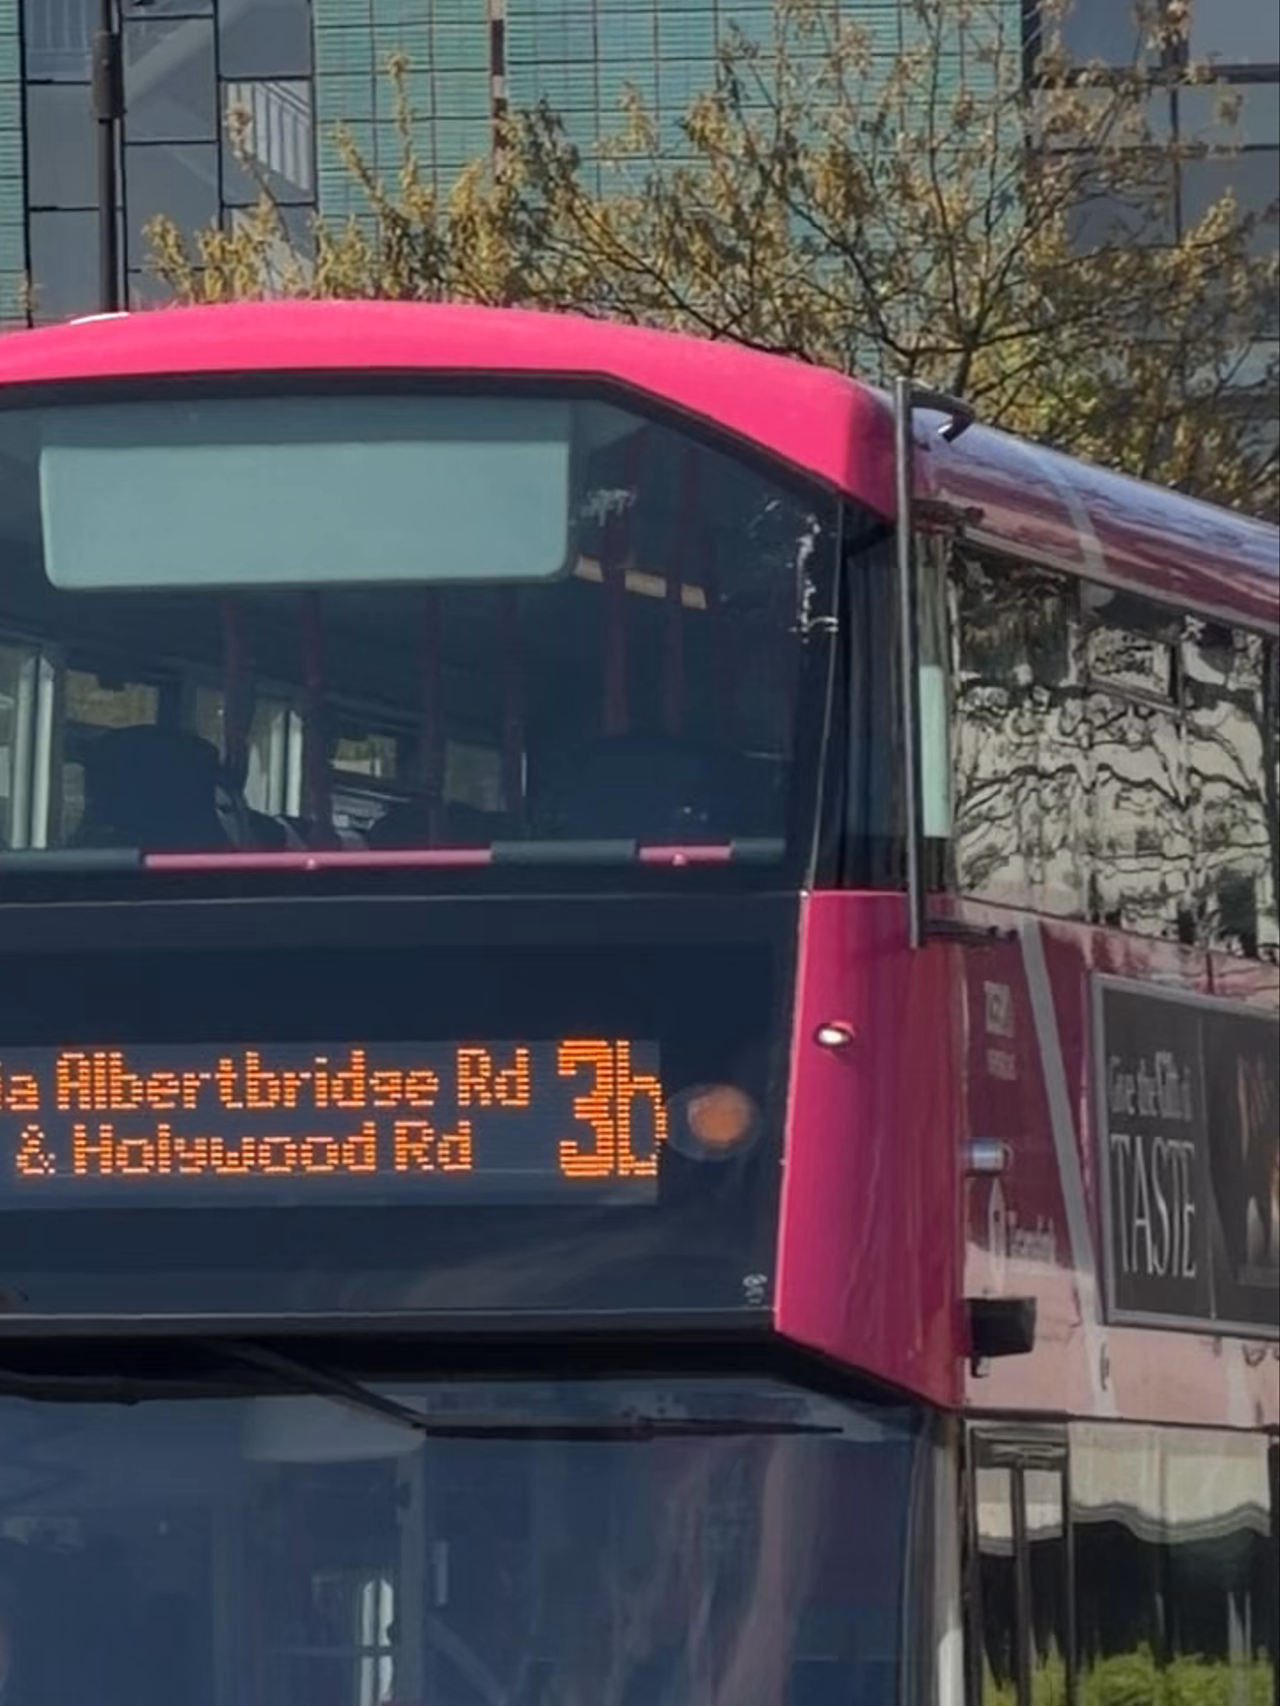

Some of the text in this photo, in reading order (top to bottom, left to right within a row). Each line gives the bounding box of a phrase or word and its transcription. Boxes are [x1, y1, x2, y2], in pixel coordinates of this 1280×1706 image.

[56, 1052, 436, 1111] Albertbridge
[458, 1048, 528, 1109] Rd
[557, 1038, 665, 1177] 3b
[14, 1121, 472, 1174] & Holywood Rd
[1110, 1133, 1195, 1278] TASTE
